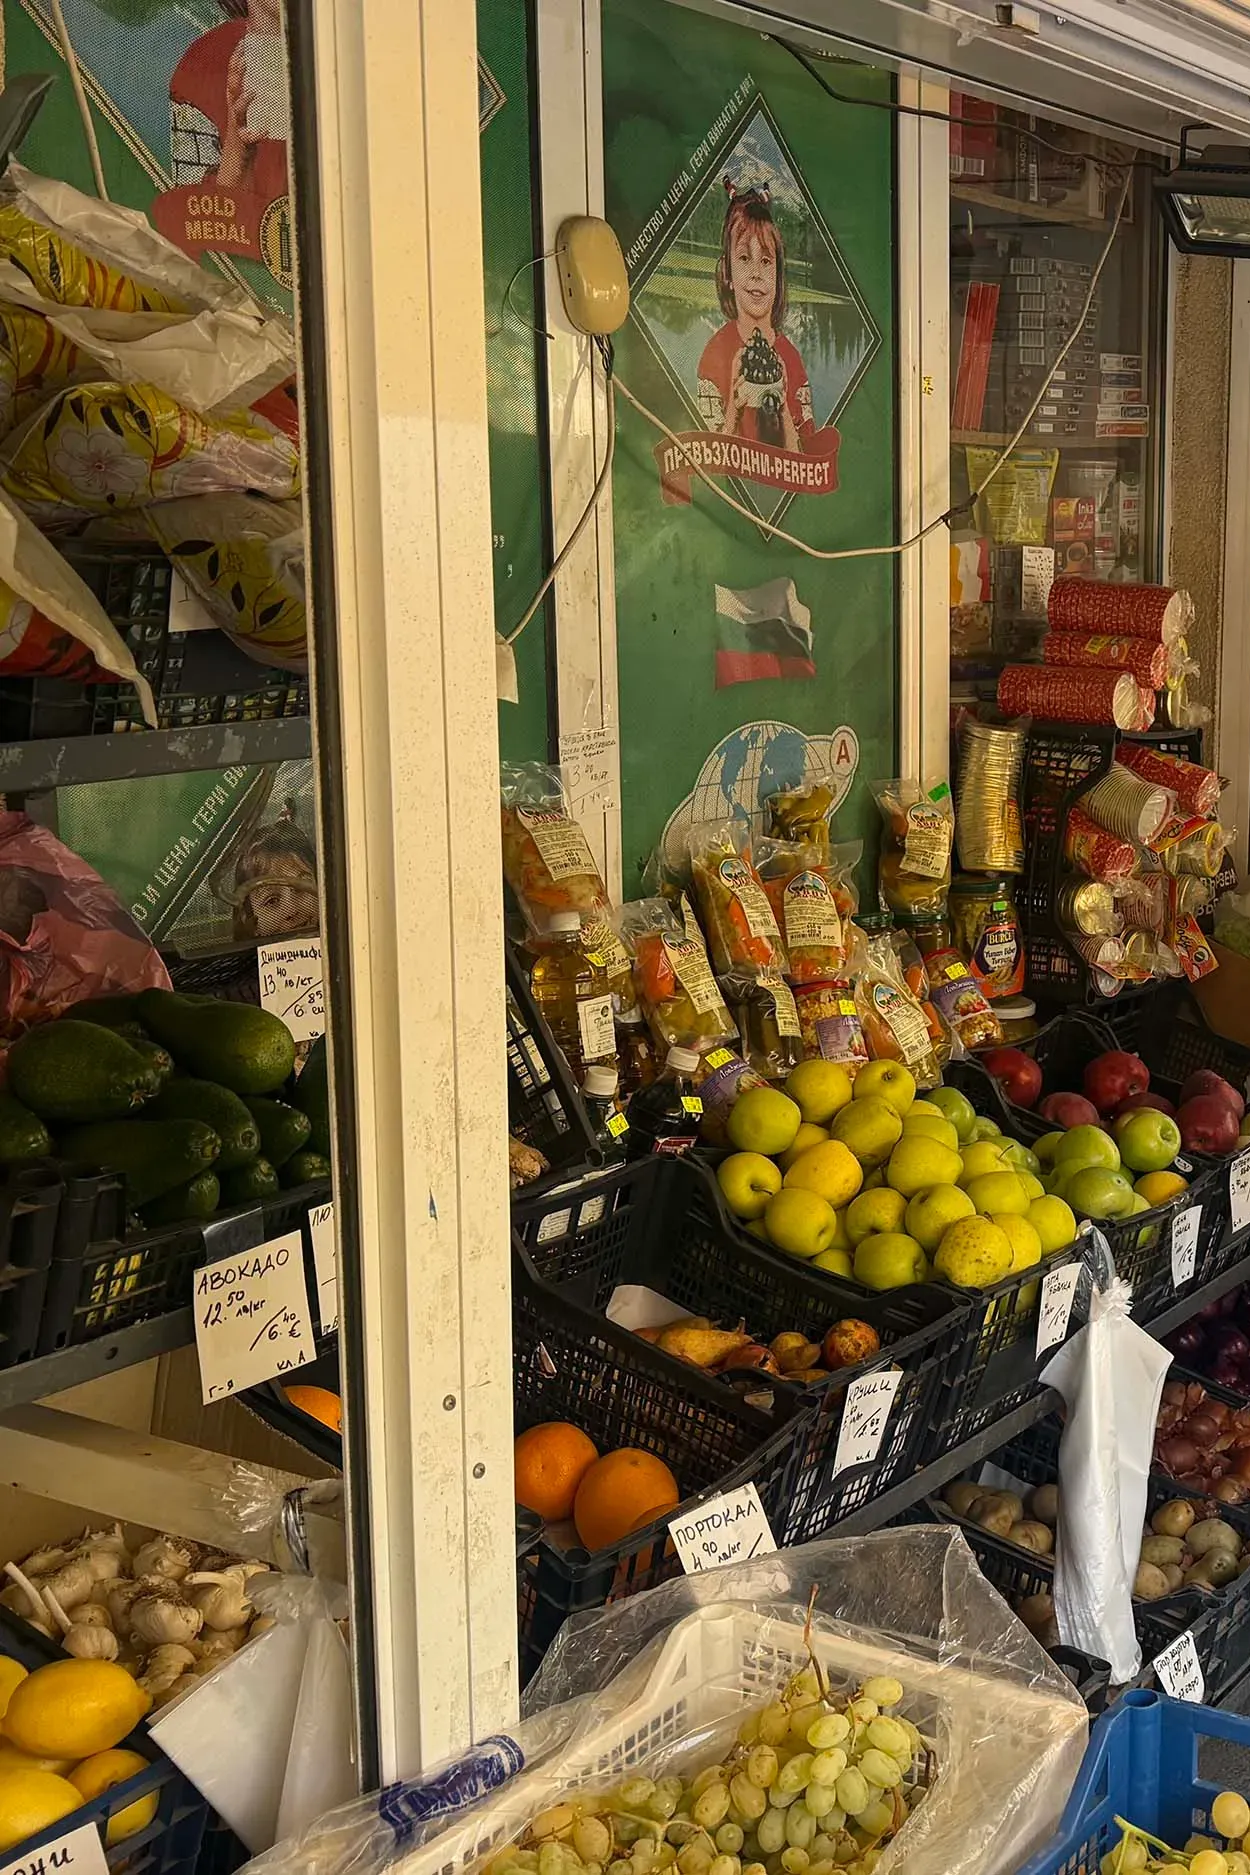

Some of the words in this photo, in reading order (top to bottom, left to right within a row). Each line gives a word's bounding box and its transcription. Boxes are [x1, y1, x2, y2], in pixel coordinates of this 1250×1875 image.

[187, 194, 236, 218] GOLD
[624, 210, 666, 269] КАЧЕСТВО
[663, 199, 672, 217] И
[669, 170, 695, 206] ЦЕНА,
[689, 139, 712, 173] ГЕРИ
[707, 100, 739, 147] ВИНАГИ
[184, 219, 251, 245] MEDAL
[191, 784, 230, 833] ГЕРИ
[142, 883, 161, 905] И
[154, 835, 201, 887] ЦЕНА,
[197, 1248, 290, 1295] АВОКАДО
[675, 1499, 758, 1548] ПОРТОКАЛ
